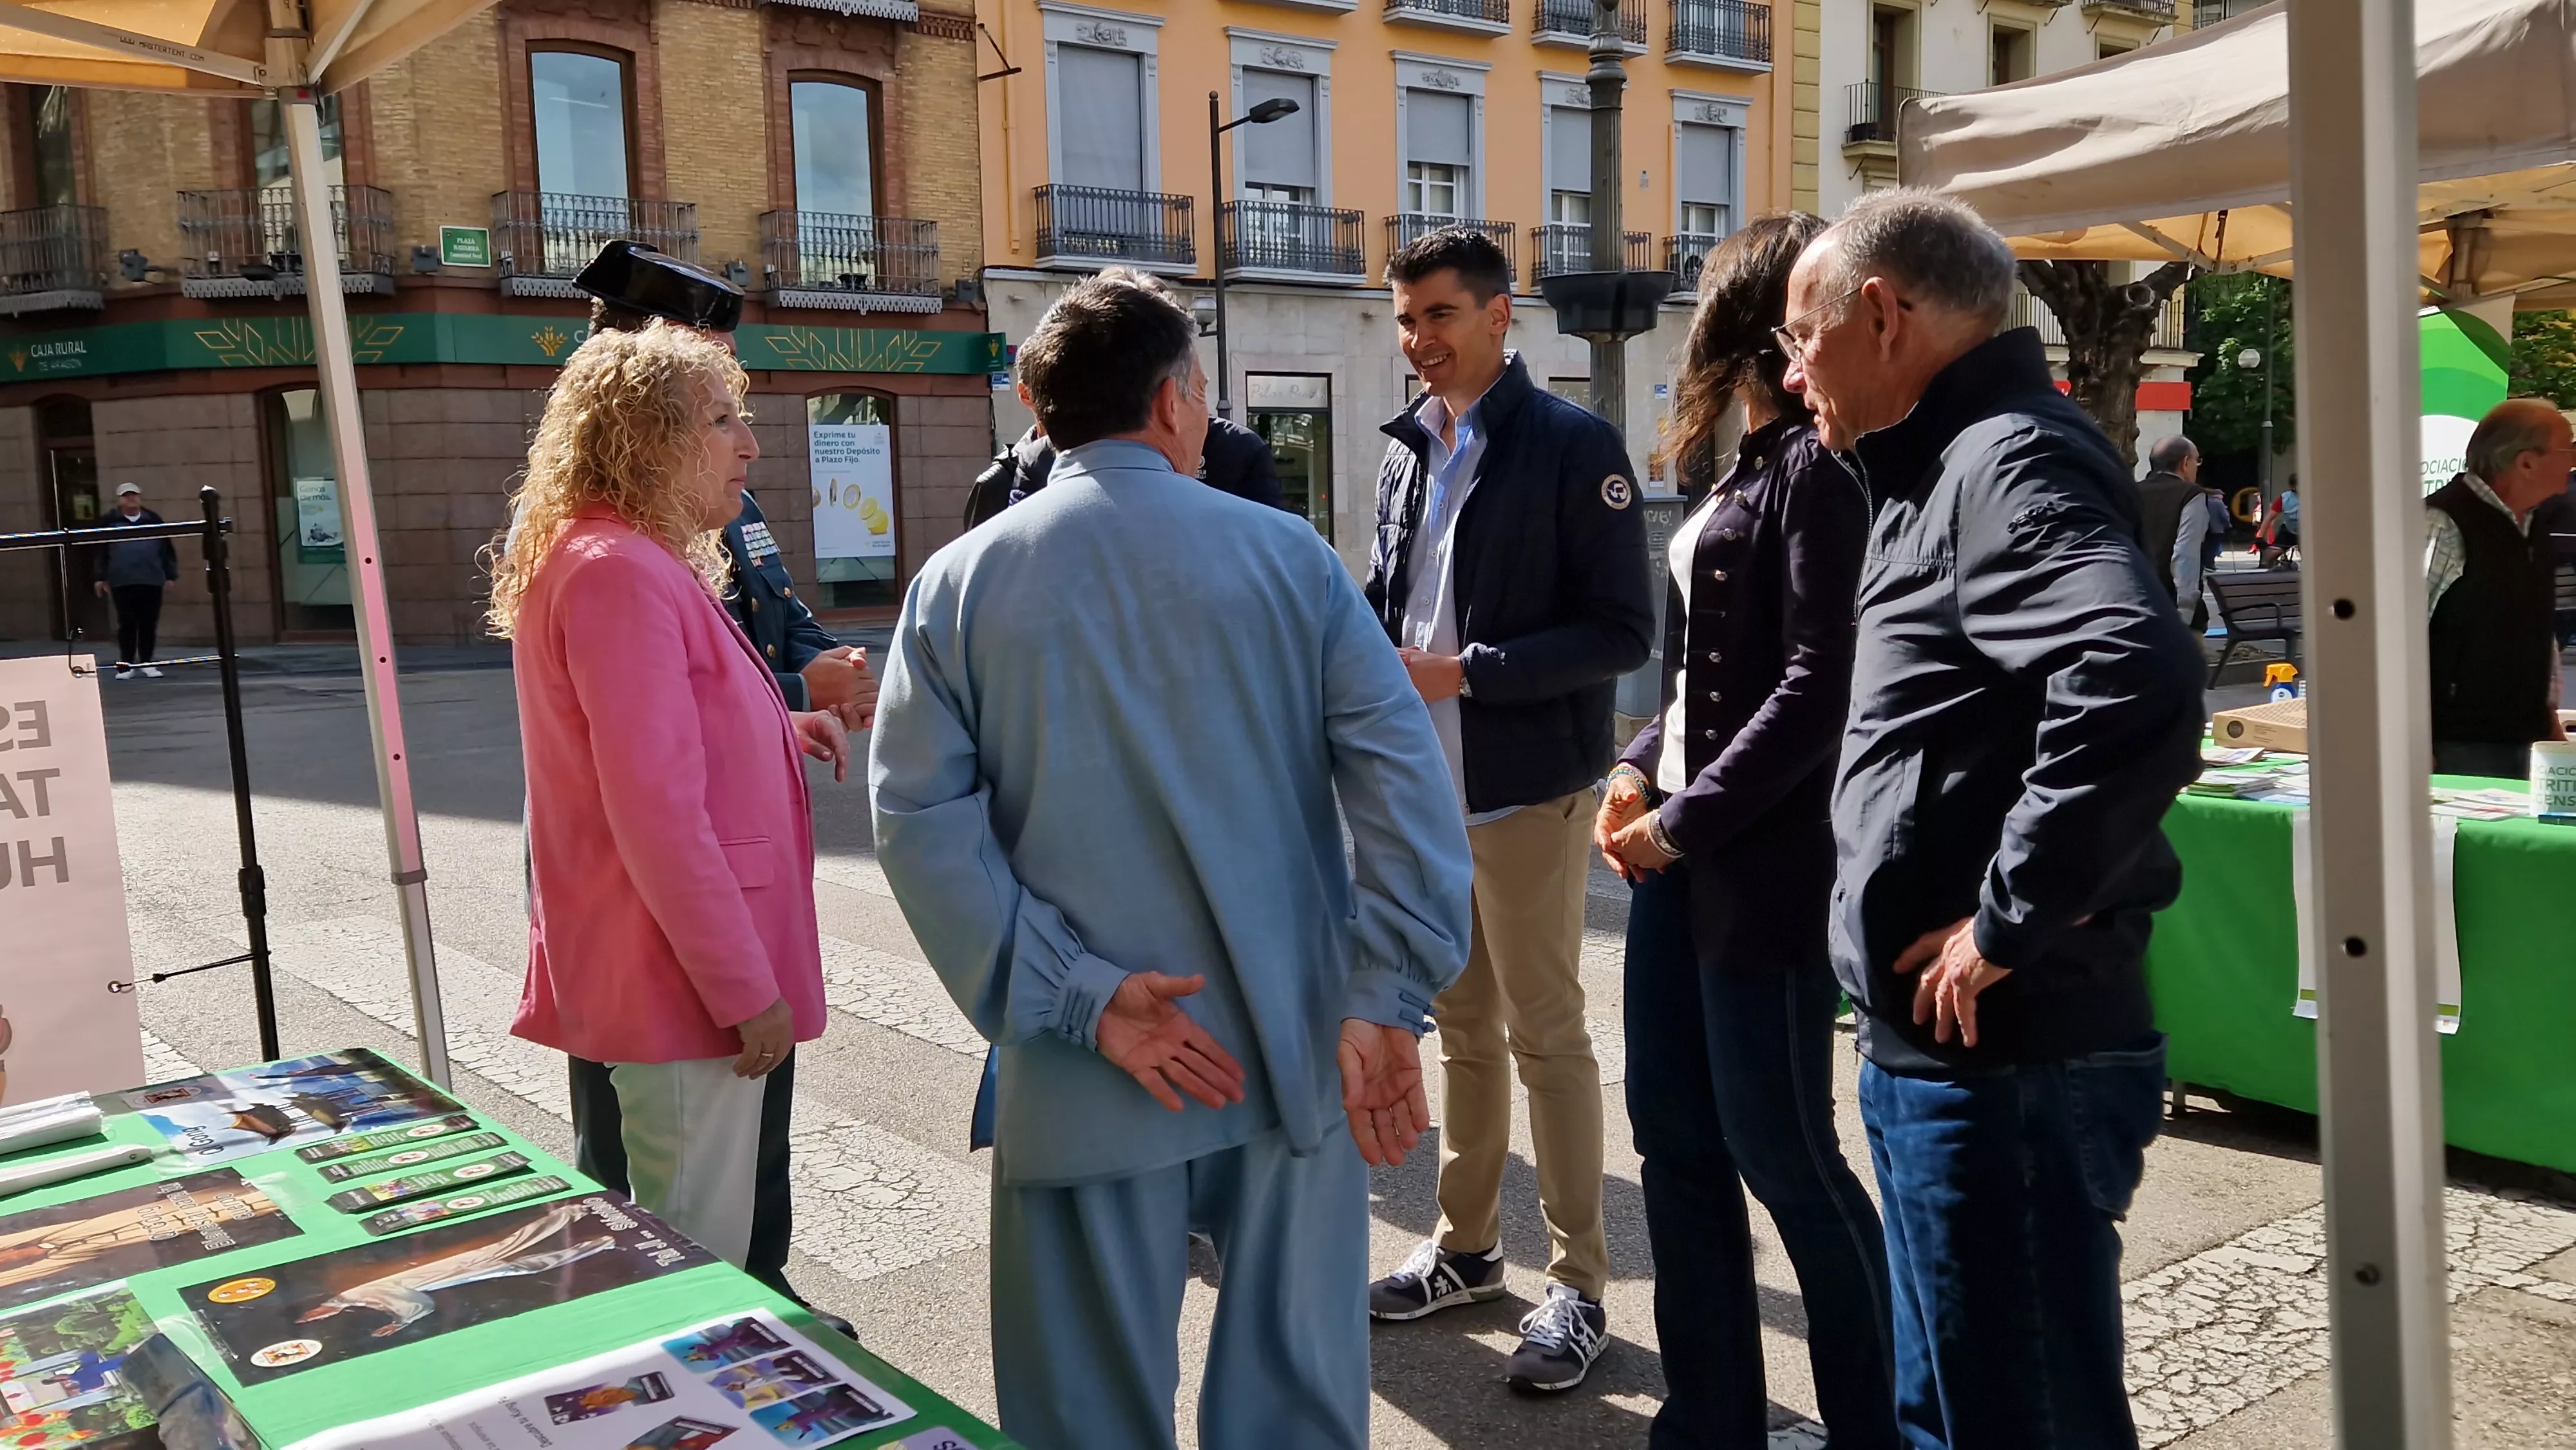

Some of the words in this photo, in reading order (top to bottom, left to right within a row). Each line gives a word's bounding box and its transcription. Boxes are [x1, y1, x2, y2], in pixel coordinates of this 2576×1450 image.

[138, 41, 185, 58] MASTERTENT
[31, 344, 53, 357] CAJA
[55, 341, 88, 355] RURAL
[813, 431, 846, 440] Exprime
[821, 455, 843, 464] Plazo
[846, 447, 881, 457] Depósito
[181, 1125, 214, 1147] Gong
[156, 1182, 184, 1194] tu
[166, 1190, 199, 1212] para
[213, 1192, 256, 1220] cuerpo
[137, 1205, 167, 1231] Gong
[185, 1211, 237, 1251] Bienestar
[647, 1247, 686, 1267] Tai
[505, 1402, 524, 1418] Kung
[524, 1423, 553, 1448] Descubre
